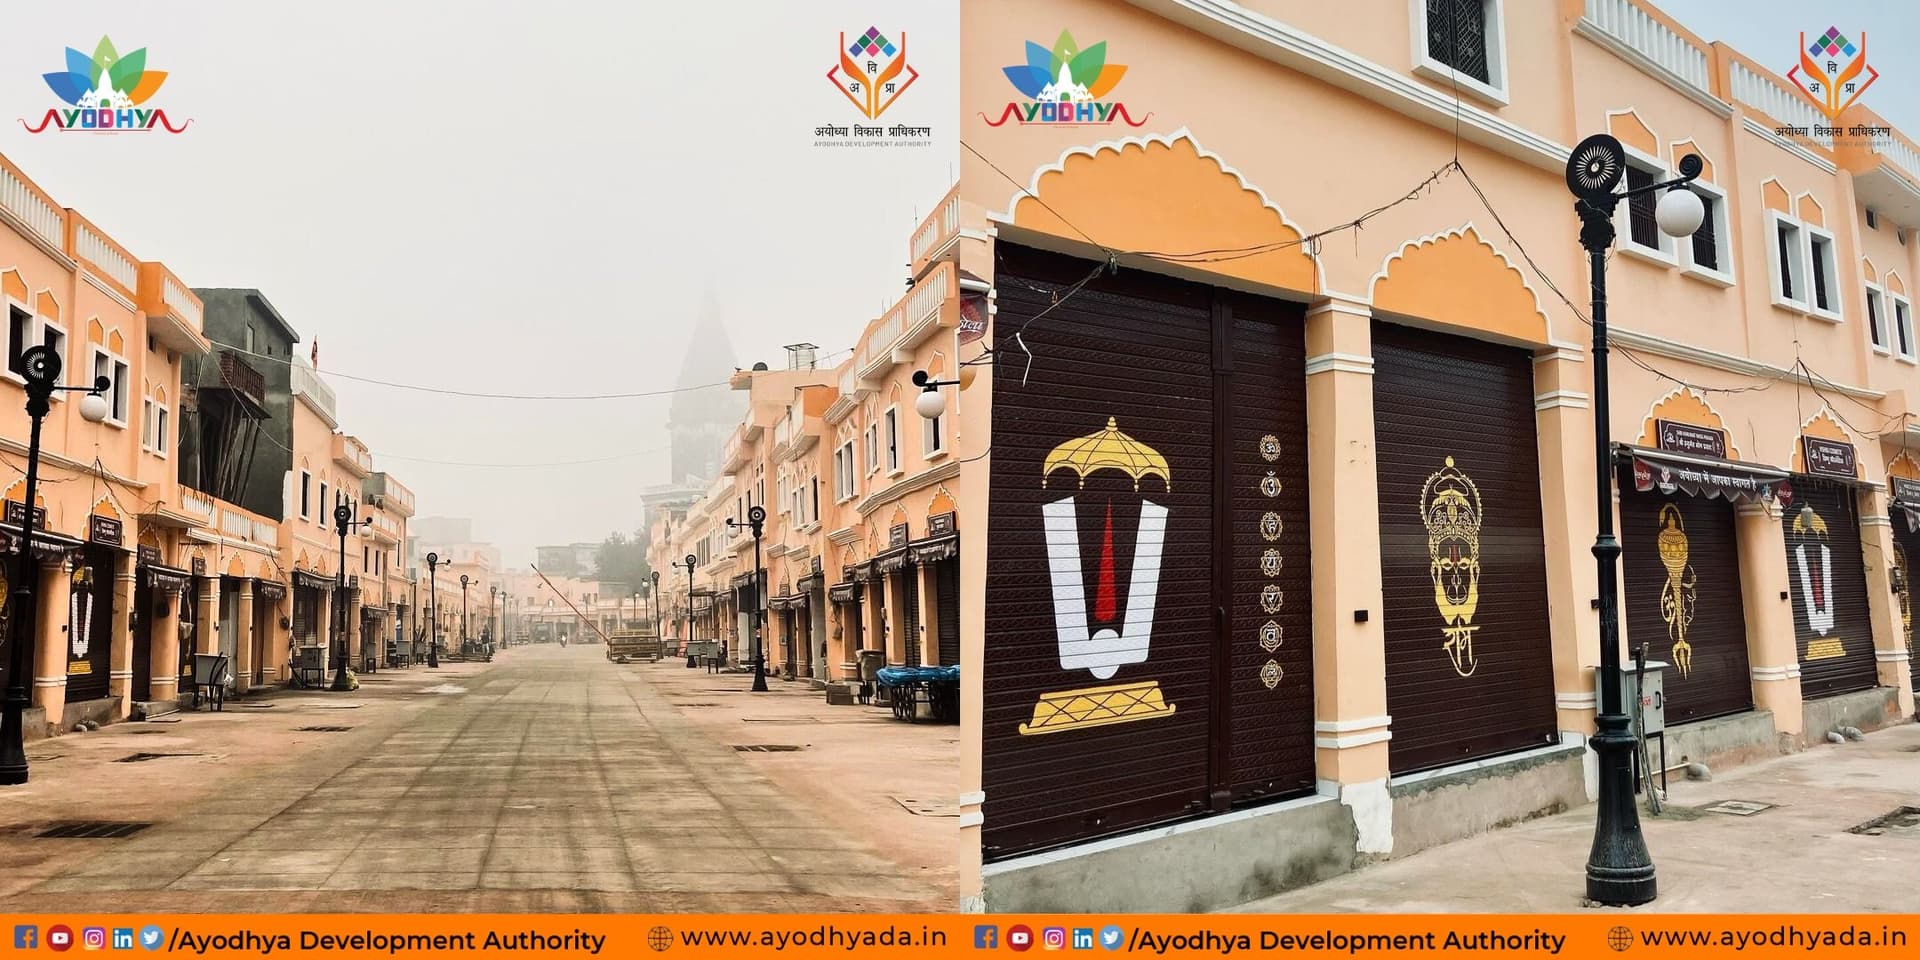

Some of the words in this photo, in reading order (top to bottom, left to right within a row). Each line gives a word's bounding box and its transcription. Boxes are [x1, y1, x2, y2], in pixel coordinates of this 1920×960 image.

[1678, 467, 1702, 484] अयोध्या
[1702, 470, 1710, 484] में
[1711, 474, 1731, 488] आपका
[1732, 476, 1751, 489] स्वागत
[1441, 617, 1481, 677] राम
